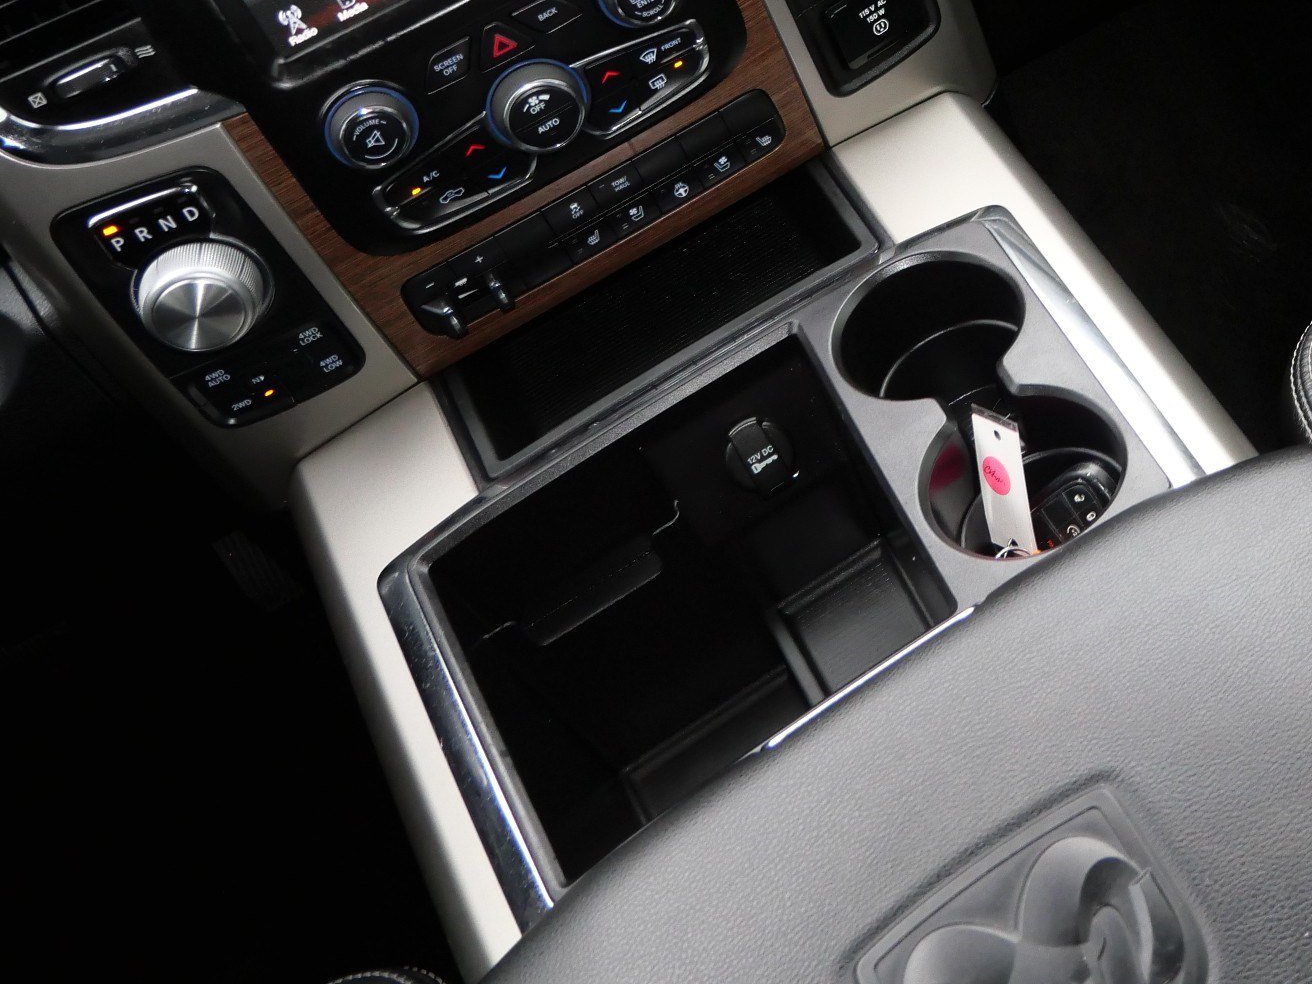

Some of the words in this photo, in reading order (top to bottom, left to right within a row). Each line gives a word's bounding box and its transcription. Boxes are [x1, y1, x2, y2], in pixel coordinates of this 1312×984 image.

[537, 6, 558, 22] BACK
[641, 4, 664, 18] SCROLL
[866, 12, 878, 23] 150
[877, 8, 885, 16] W
[661, 37, 682, 52] FRONT
[434, 53, 464, 73] SCREEN
[443, 65, 458, 76] OFF
[529, 102, 546, 115] OFF
[354, 118, 380, 136] VOLUME
[537, 118, 560, 134] AUTO
[422, 170, 440, 183] A/C
[572, 208, 584, 219] OFF
[110, 238, 125, 252] P
[134, 227, 153, 243] R
[158, 215, 177, 232] N
[182, 206, 199, 222] D
[299, 327, 319, 340] 4WD
[300, 332, 323, 346] LOCK
[319, 354, 339, 367] 4WD
[323, 360, 343, 373] LOW
[205, 369, 225, 382] 4WD
[208, 373, 231, 387] AUTO
[231, 399, 252, 411] 2WD
[747, 452, 761, 464] 12V
[761, 445, 774, 456] DC
